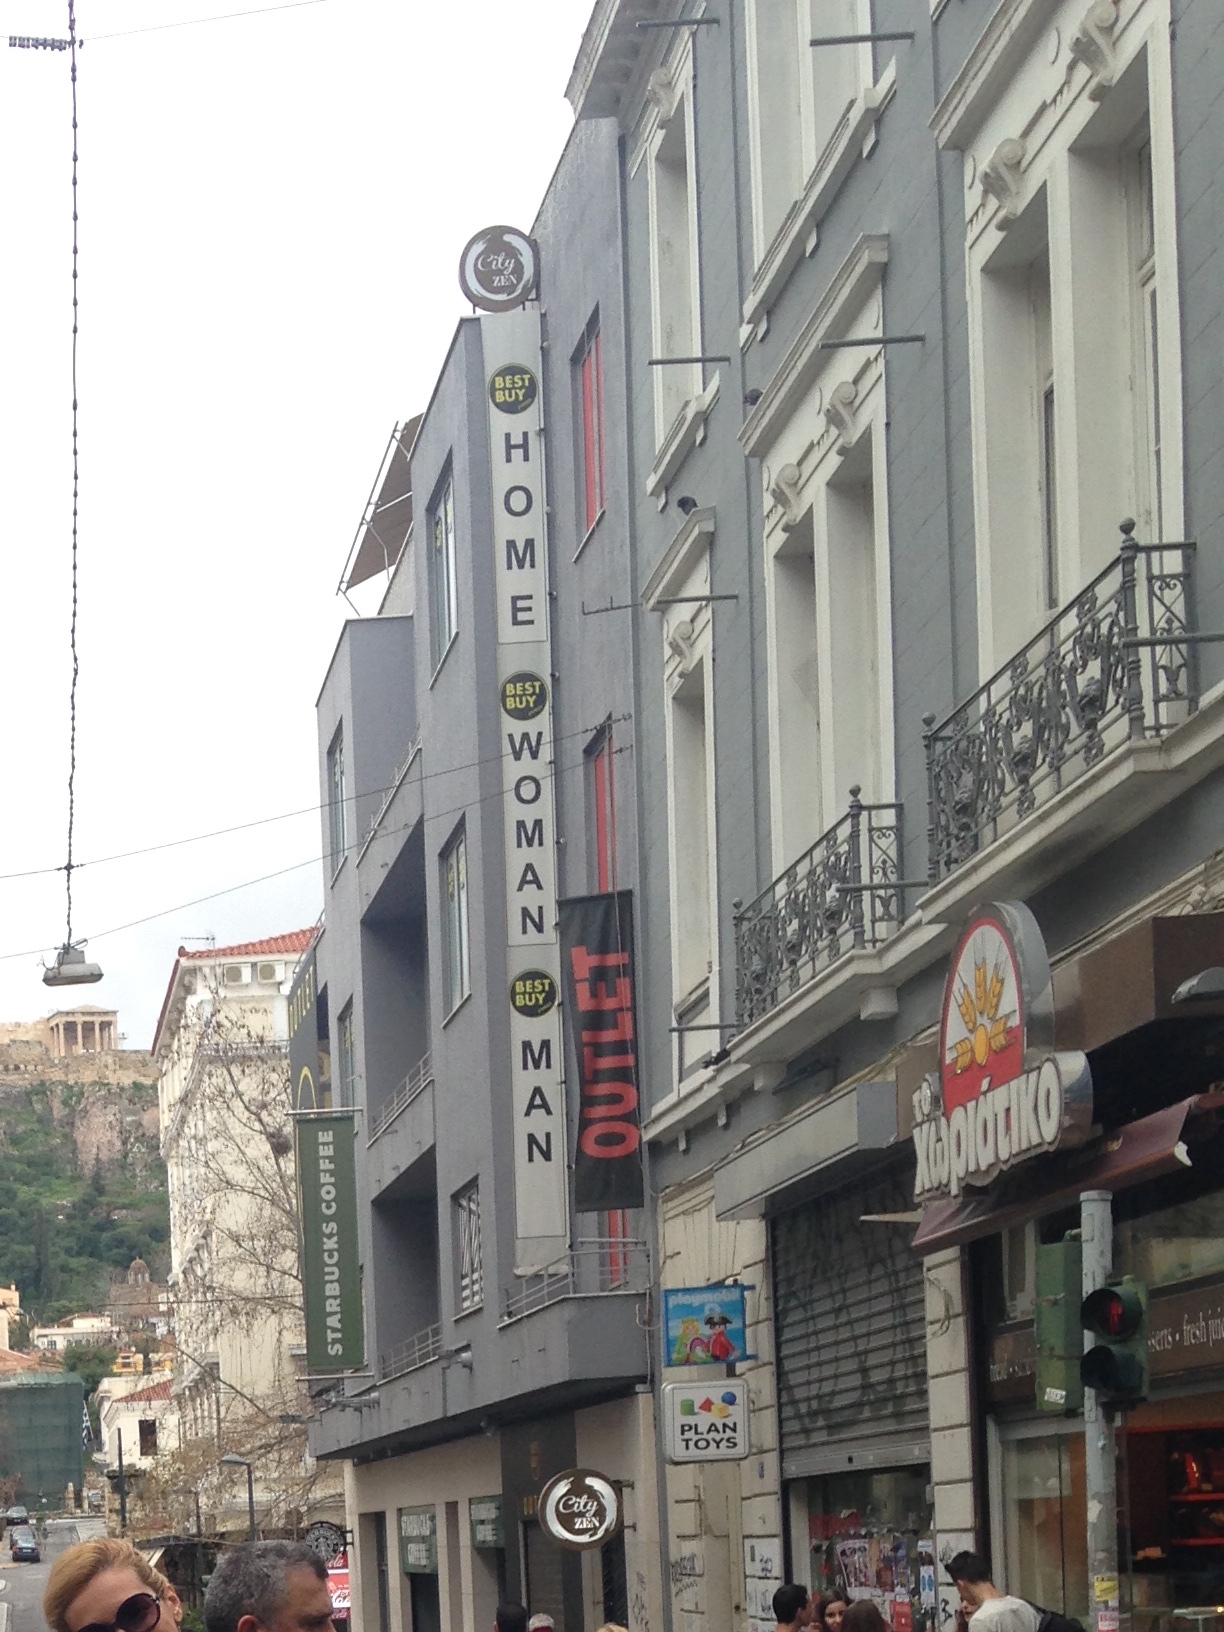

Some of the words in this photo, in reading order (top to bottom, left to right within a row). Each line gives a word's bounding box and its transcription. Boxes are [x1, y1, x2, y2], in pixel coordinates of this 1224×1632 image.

[478, 251, 515, 275] City
[492, 274, 517, 287] ZEN
[495, 374, 531, 389] BEST
[495, 389, 526, 403] BUY
[503, 431, 536, 627] HOME
[505, 681, 541, 696] BEST
[506, 696, 537, 710] BUY
[507, 731, 544, 935] WOMAN
[515, 979, 551, 993] BEST
[515, 993, 546, 1007] BUY
[571, 945, 640, 1159] OUTLET
[521, 1038, 553, 1163] MAN
[318, 1130, 337, 1215] COFFEE
[323, 1220, 343, 1356] STARBUCKS
[680, 1421, 738, 1436] PLAN
[680, 1436, 738, 1451] TOYS
[559, 1494, 600, 1517] City
[574, 1516, 600, 1529] ZEN
